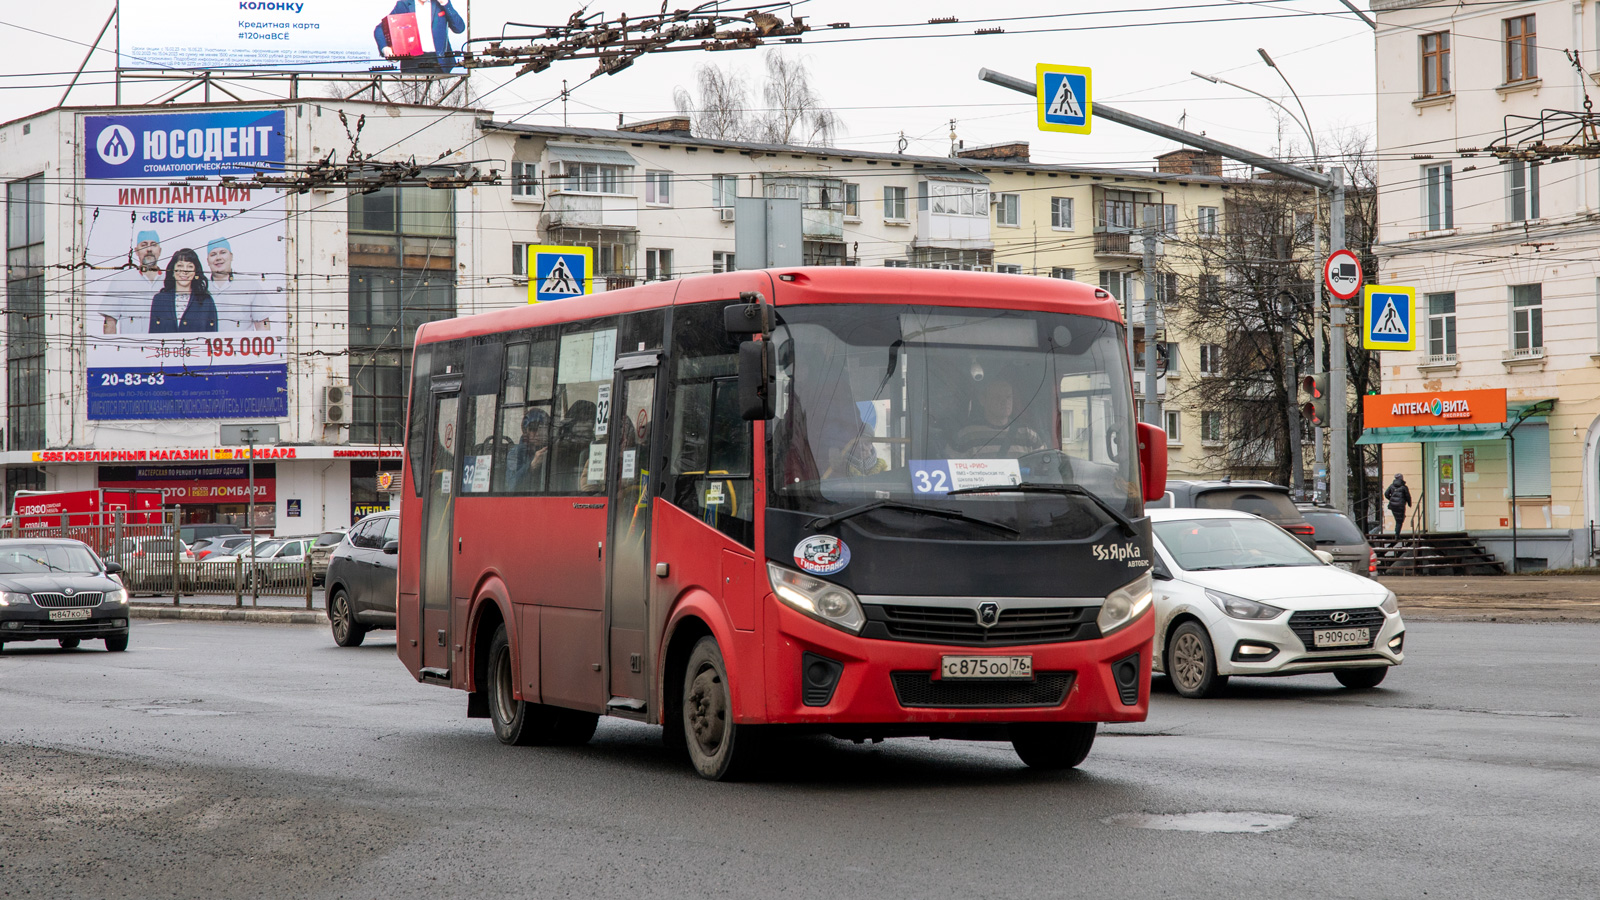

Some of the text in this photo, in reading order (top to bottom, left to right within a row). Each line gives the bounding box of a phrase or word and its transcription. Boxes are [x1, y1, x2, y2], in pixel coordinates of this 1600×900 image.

[239, 1, 304, 14] колонку
[238, 20, 320, 30] Кредитная карта
[238, 32, 290, 40] #120наВСЁ
[143, 126, 273, 162] ЮСОДЕНТ
[144, 162, 230, 172] СТОМАТОЛОГИЧЕСКАЯ
[118, 186, 251, 206] ИМПЛАНТАЦИЯ
[142, 208, 174, 223] «ВСЁ
[178, 210, 195, 222] НА
[101, 372, 164, 386] 20-83-63
[597, 400, 609, 424] 32
[1391, 400, 1469, 415] АПТЕКА ВИТА
[42, 452, 63, 462] 585
[65, 450, 146, 462] ЮВЕЛИРНЫЙ
[150, 449, 208, 461] МАГАЗИН
[234, 448, 296, 459] ЛОМБАРД
[223, 467, 244, 475] ОДЕЖДЫ
[463, 465, 474, 484] 32
[915, 470, 949, 492] 32
[210, 486, 267, 496] ЛОМБАРД
[25, 504, 46, 515] ДЭФО
[1110, 542, 1141, 562] ЯрКа
[800, 558, 844, 572] ГИРФТРАНС
[1128, 560, 1149, 568] АВТОБУС
[1358, 629, 1367, 638] 76
[948, 658, 1026, 675] С875ОО 76
